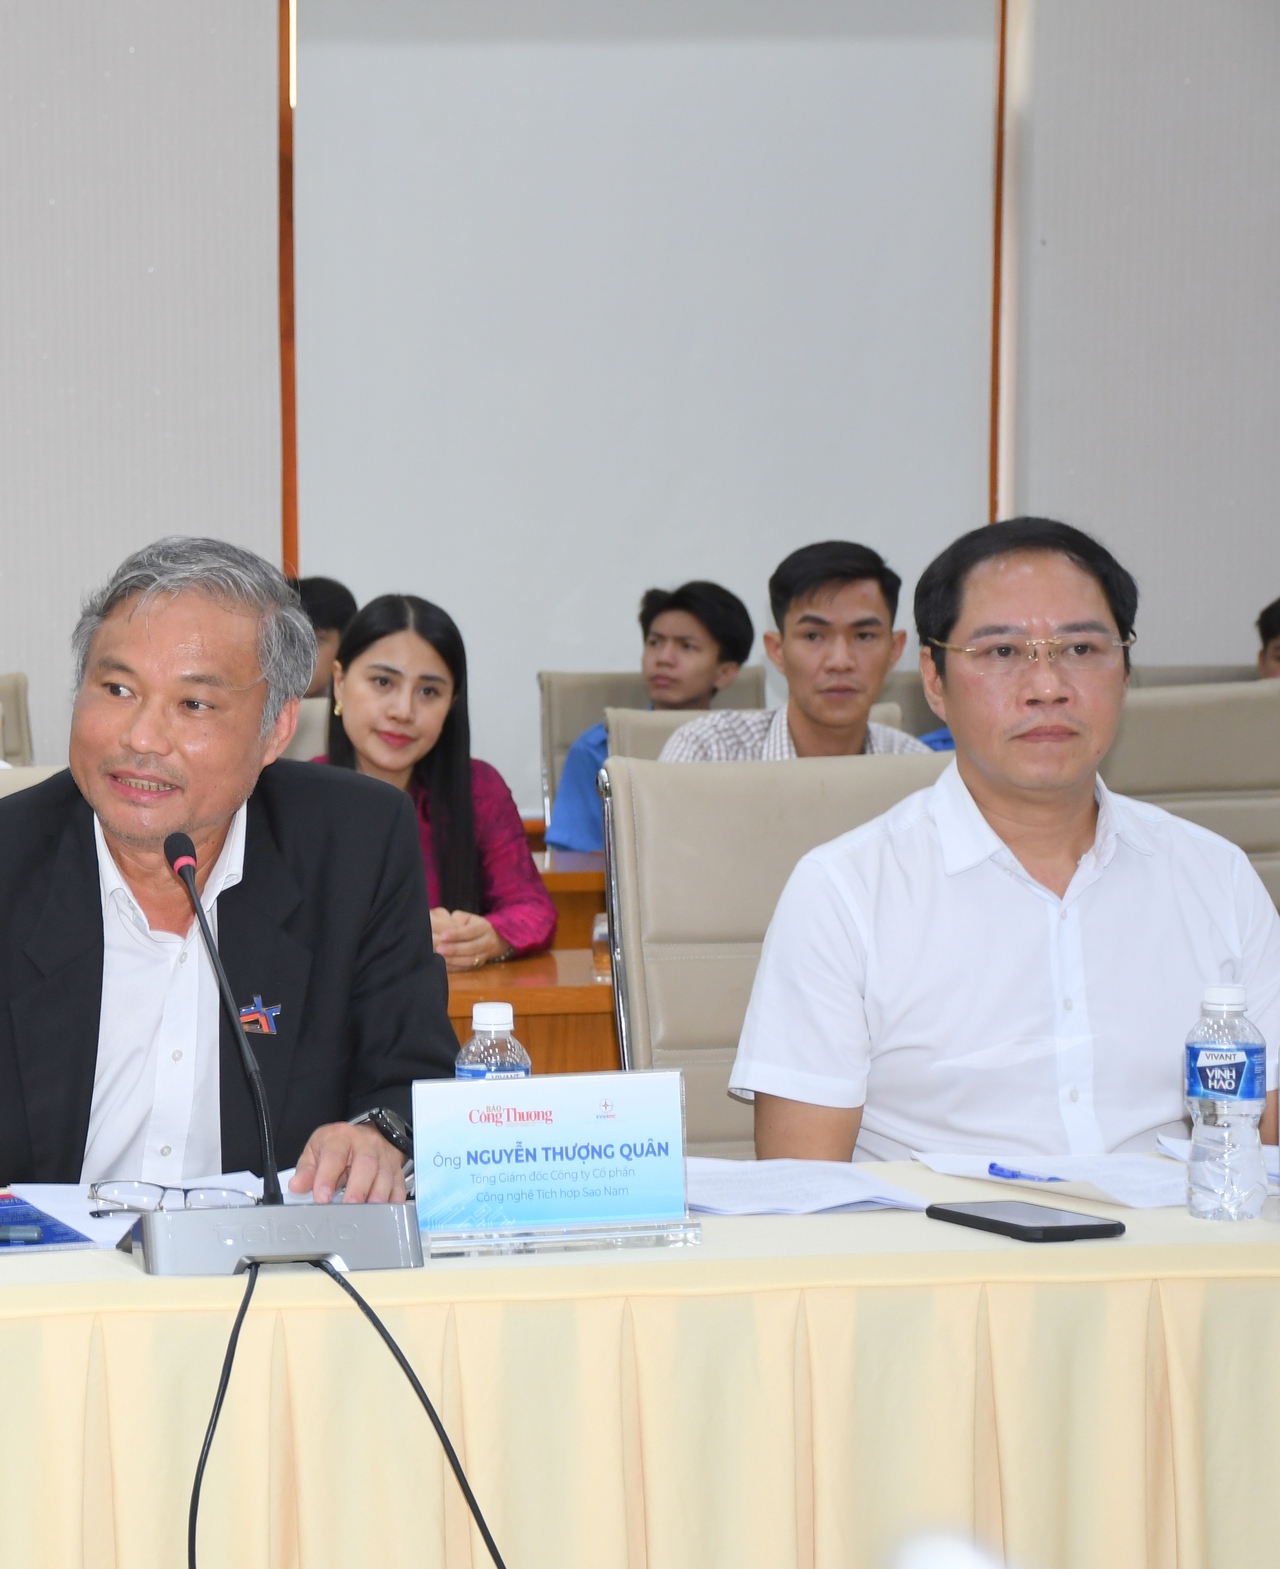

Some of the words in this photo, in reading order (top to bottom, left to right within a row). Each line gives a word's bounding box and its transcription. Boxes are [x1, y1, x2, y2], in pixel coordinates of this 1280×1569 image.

[1205, 1053, 1237, 1061] VIVANT
[486, 1104, 502, 1113] BÁO
[468, 1109, 504, 1127] Công
[433, 1151, 462, 1169] Ông
[466, 1141, 537, 1166] NGUYỄN
[541, 1143, 615, 1164] THƯỢNG
[619, 1138, 669, 1161] QUÂN
[498, 1172, 527, 1182] Giám
[529, 1171, 549, 1181] đốc
[550, 1169, 578, 1181] Công
[580, 1168, 591, 1180] ty
[476, 1190, 504, 1204] Công
[506, 1191, 535, 1202] nghệ
[536, 1189, 558, 1199] Tích
[582, 1187, 602, 1197] Sao
[603, 1186, 629, 1196] Nam
